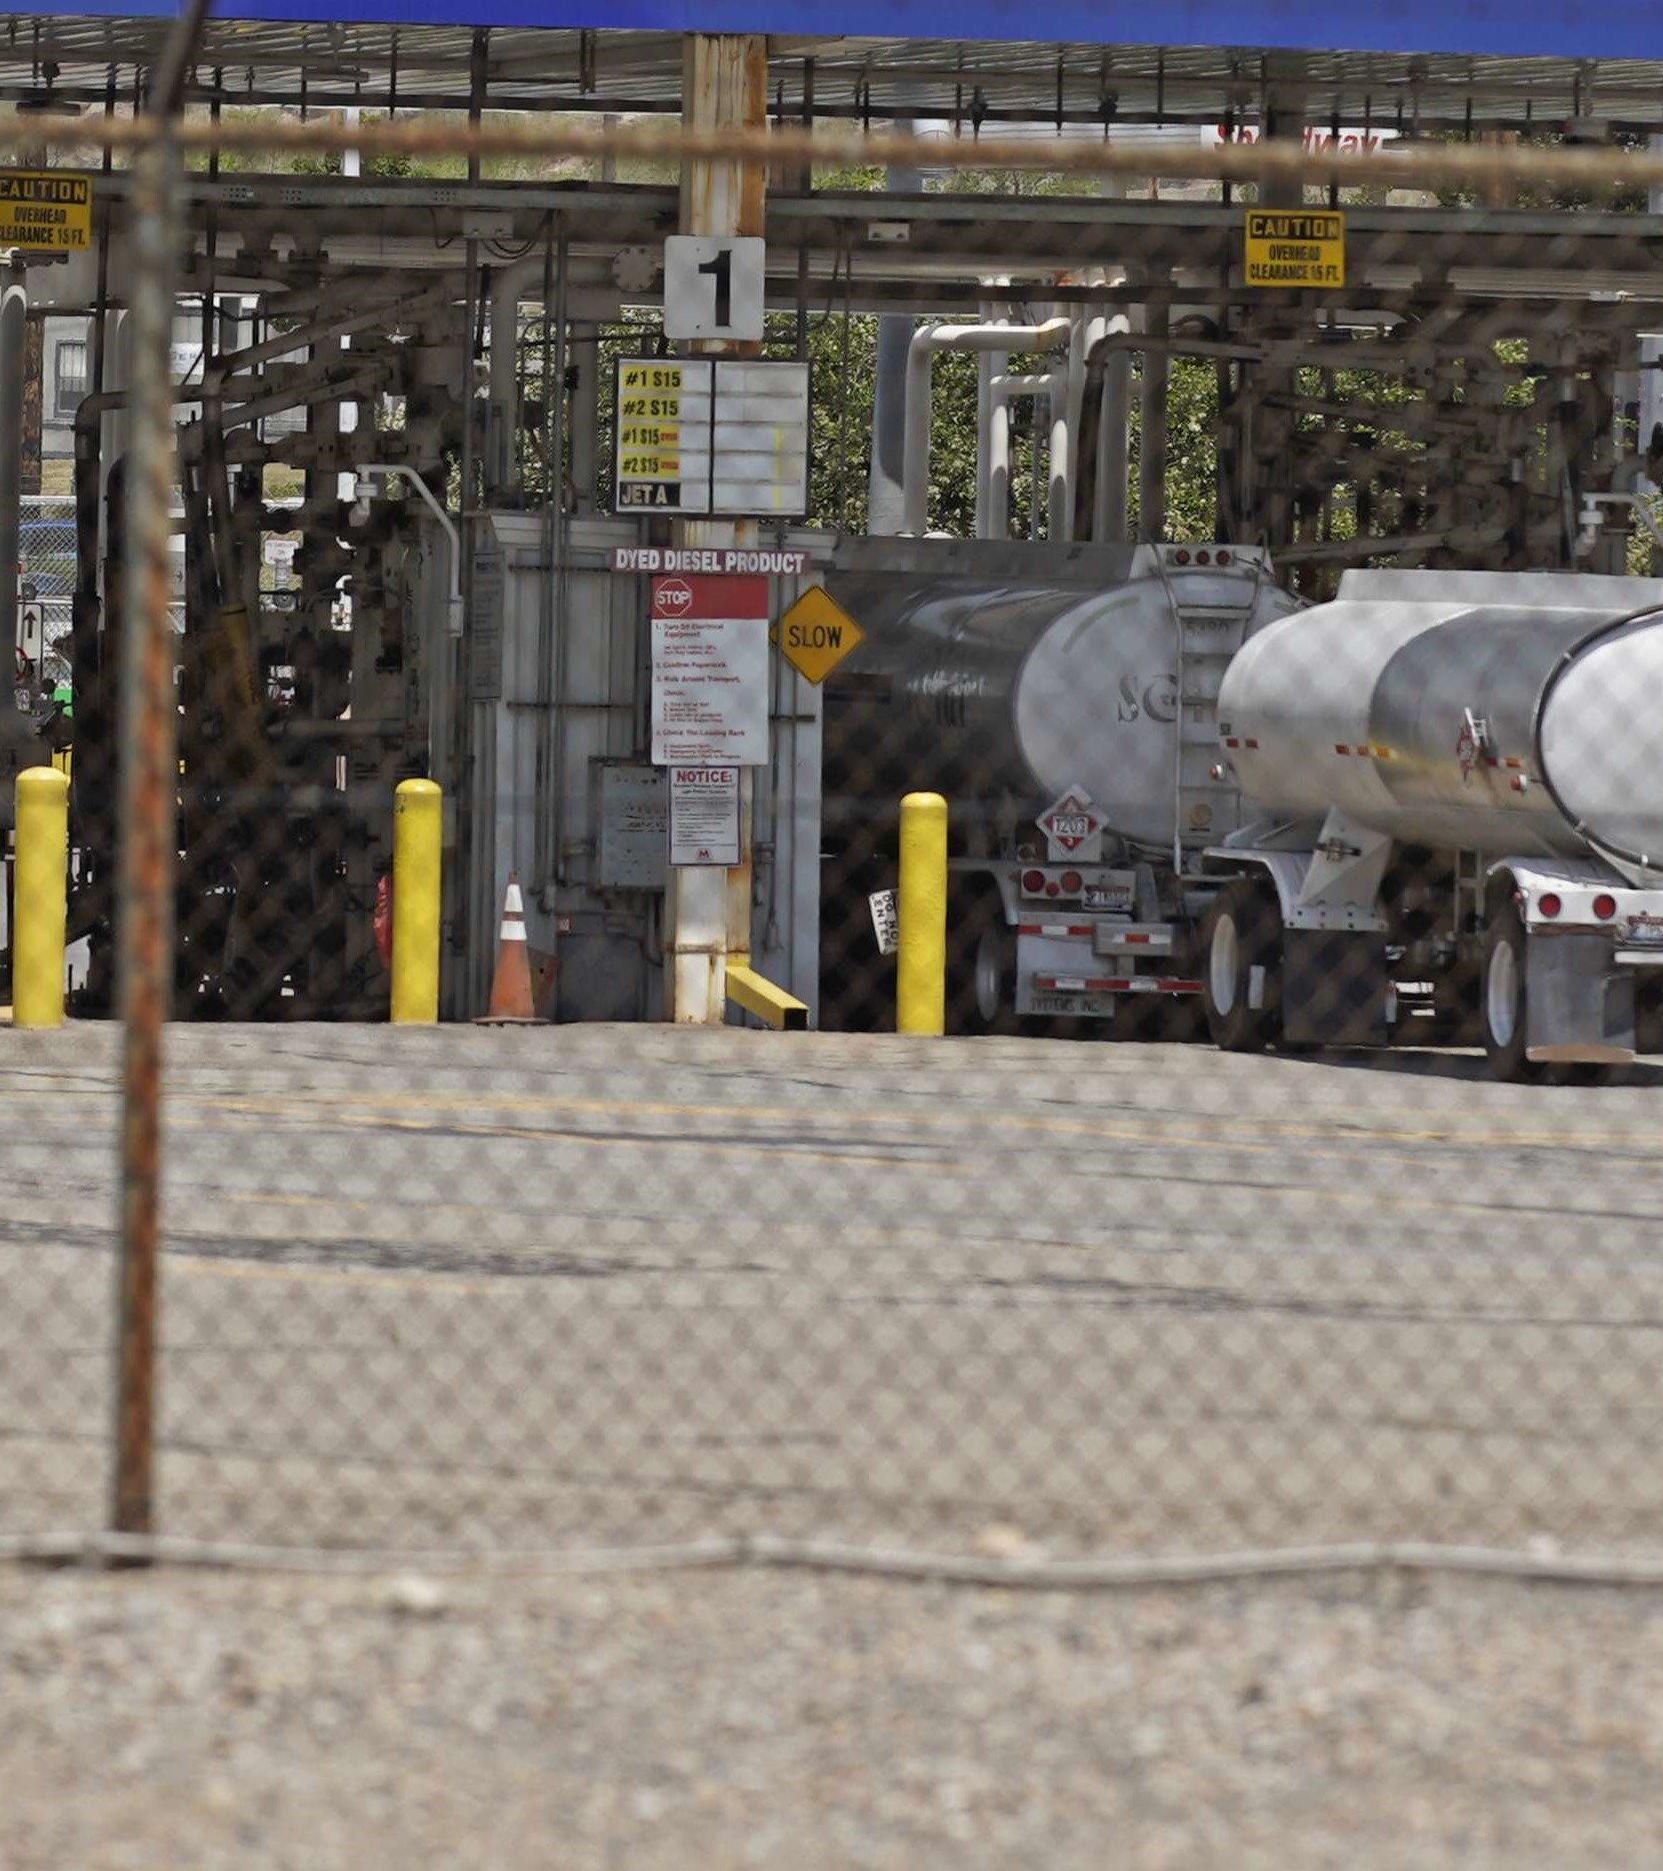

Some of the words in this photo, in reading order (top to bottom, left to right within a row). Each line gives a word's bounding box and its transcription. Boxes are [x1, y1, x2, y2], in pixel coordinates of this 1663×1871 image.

[14, 207, 67, 224] OVERHEAD
[58, 228, 70, 244] 15
[1252, 218, 1338, 238] CAUTION
[1269, 244, 1321, 261] OVERHEAD
[1250, 264, 1309, 280] CLEARANCE
[698, 250, 732, 328] 1
[625, 371, 647, 387] #1
[653, 371, 681, 387] S15
[623, 400, 646, 416] #2
[650, 400, 679, 416] S15
[622, 428, 637, 444] #1
[640, 428, 660, 445] S15
[622, 457, 638, 473] #2
[640, 457, 659, 474] S15
[621, 485, 653, 505] JET
[656, 485, 668, 505] A
[616, 548, 660, 570] DYED
[664, 550, 722, 572] DIESEL
[725, 551, 805, 574] PRODUCT
[657, 591, 689, 606] STOP
[789, 625, 842, 649] SLOW
[1053, 817, 1087, 834] 1203
